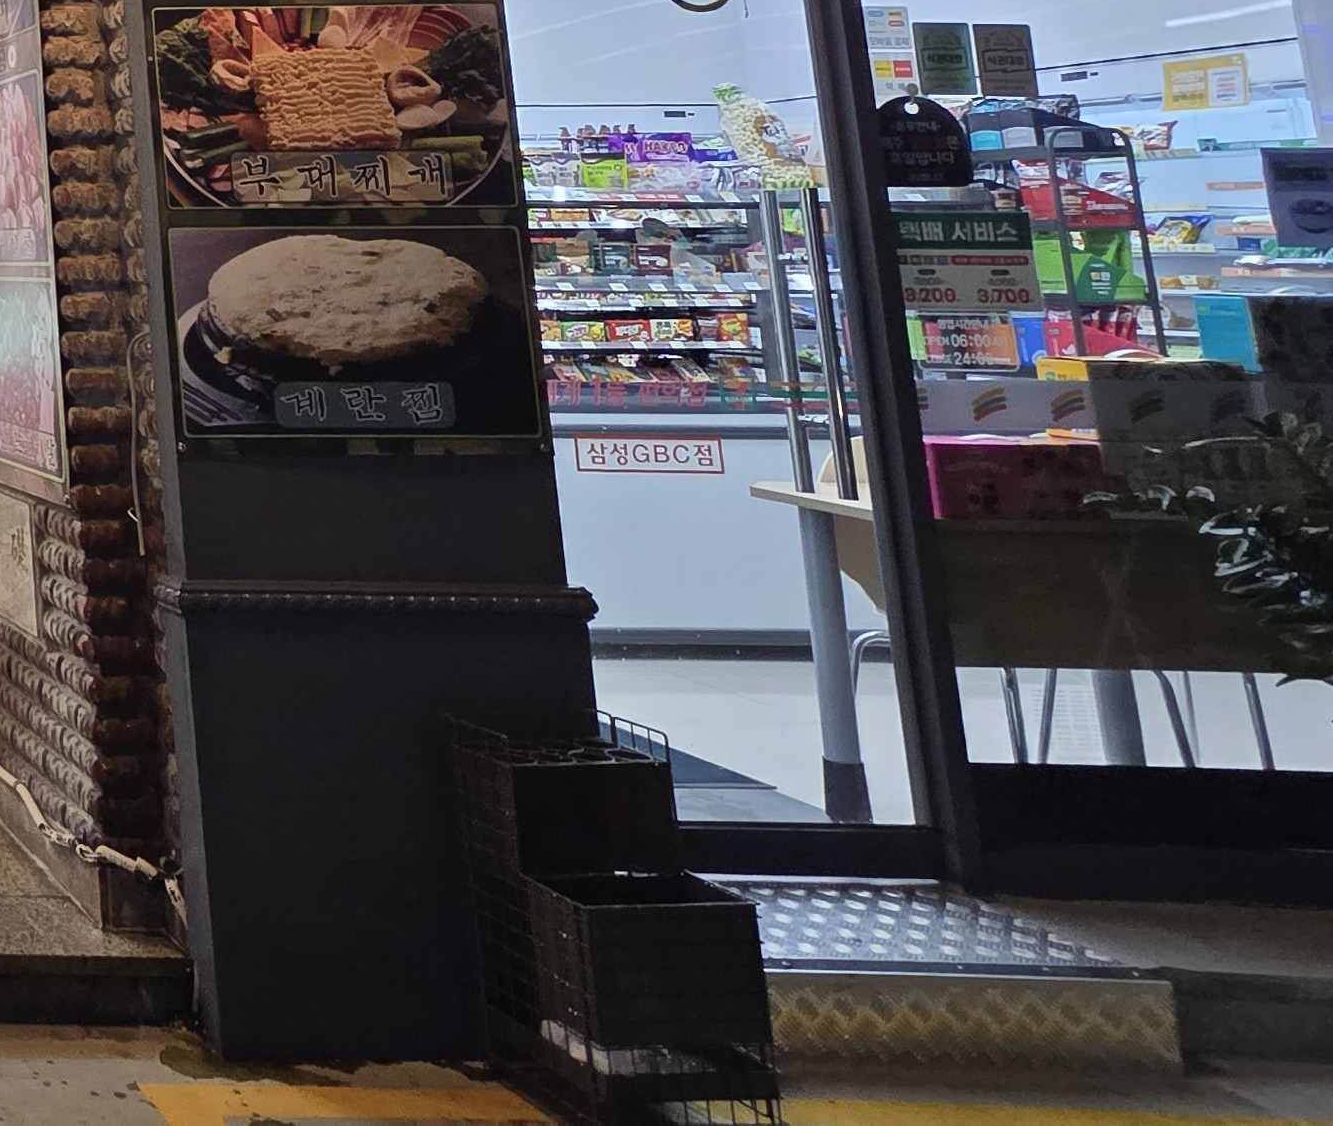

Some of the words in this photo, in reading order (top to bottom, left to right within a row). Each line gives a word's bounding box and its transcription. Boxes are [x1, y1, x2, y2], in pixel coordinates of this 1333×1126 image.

[239, 154, 451, 199] 부대찌개
[951, 221, 1019, 243] 서비스
[951, 333, 991, 347] 06:00
[277, 384, 444, 424] 계란찜
[587, 443, 714, 468] 삼성GBC점
